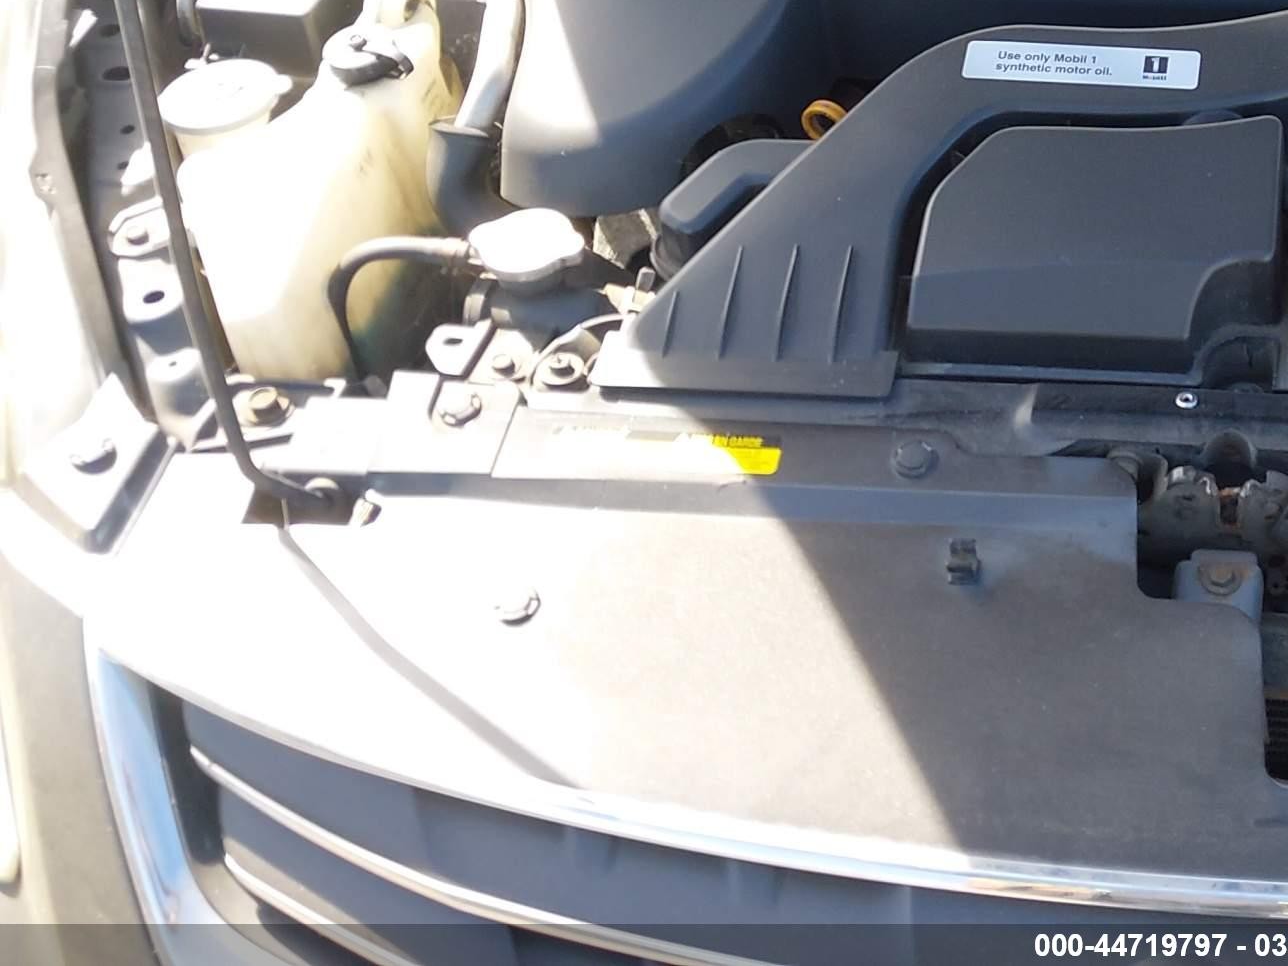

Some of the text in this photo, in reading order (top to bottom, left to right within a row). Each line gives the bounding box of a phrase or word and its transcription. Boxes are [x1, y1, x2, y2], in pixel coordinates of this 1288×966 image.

[998, 51, 1097, 64] Use only Mobil 1
[996, 63, 1112, 76] synthetic motor oil.
